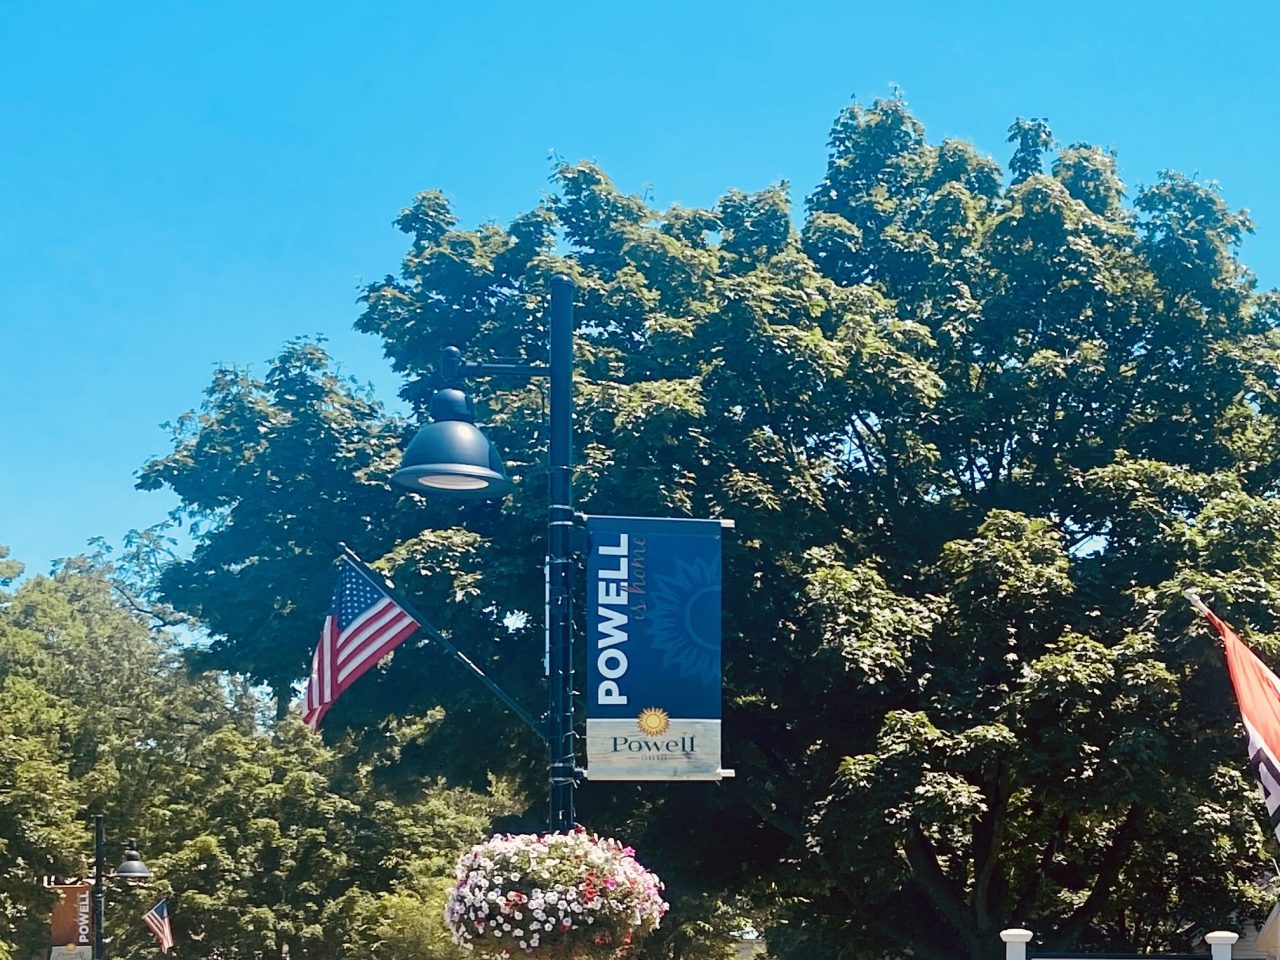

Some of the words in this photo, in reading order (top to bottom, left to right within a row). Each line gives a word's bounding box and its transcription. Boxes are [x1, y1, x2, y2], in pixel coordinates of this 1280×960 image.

[598, 533, 629, 705] POWELL
[611, 734, 697, 753] Powell
[78, 890, 90, 943] POWELL
